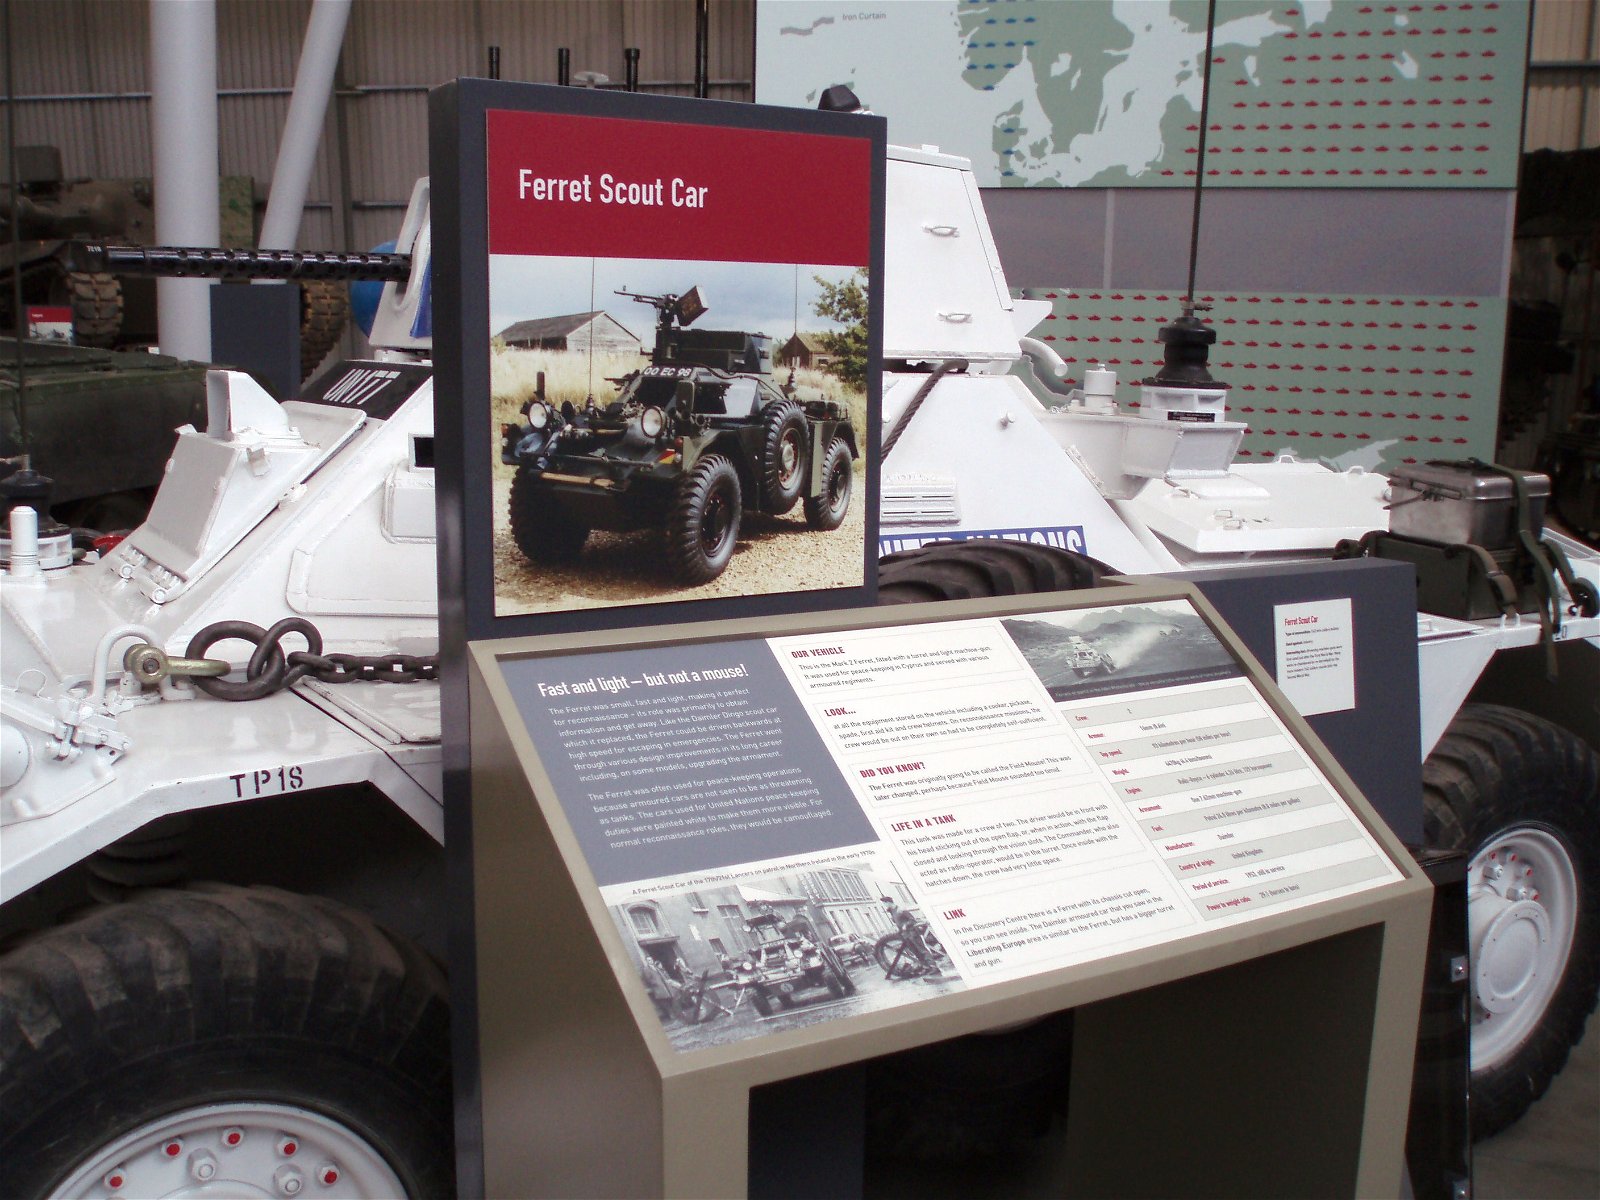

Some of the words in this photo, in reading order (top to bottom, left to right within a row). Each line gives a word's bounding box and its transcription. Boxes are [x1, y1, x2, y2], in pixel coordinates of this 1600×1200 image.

[842, 13, 857, 21] Iron
[859, 12, 886, 21] Curtain
[519, 168, 592, 203] Ferret
[599, 173, 663, 206] Scout
[671, 177, 708, 208] Car
[790, 649, 809, 658] OUR
[809, 646, 845, 656] VEHICLE
[537, 681, 570, 696] Fast
[571, 678, 597, 693] and
[596, 675, 630, 693] light
[642, 672, 668, 686] but
[667, 669, 691, 684] not
[690, 671, 701, 681] a
[701, 663, 748, 680] mouse!
[823, 707, 856, 716] LOOK...
[859, 768, 875, 778] DID
[876, 765, 894, 775] YOU
[895, 761, 925, 772] KNOW?
[604, 789, 632, 798] Ferret
[632, 787, 650, 795] was
[650, 784, 672, 792] often
[672, 780, 692, 789] used
[706, 773, 761, 786] peace-keeping
[762, 767, 801, 778] operations
[890, 821, 912, 832] LIFE
[911, 819, 923, 828] IN
[932, 813, 956, 824] TANK
[943, 908, 966, 920] LINK
